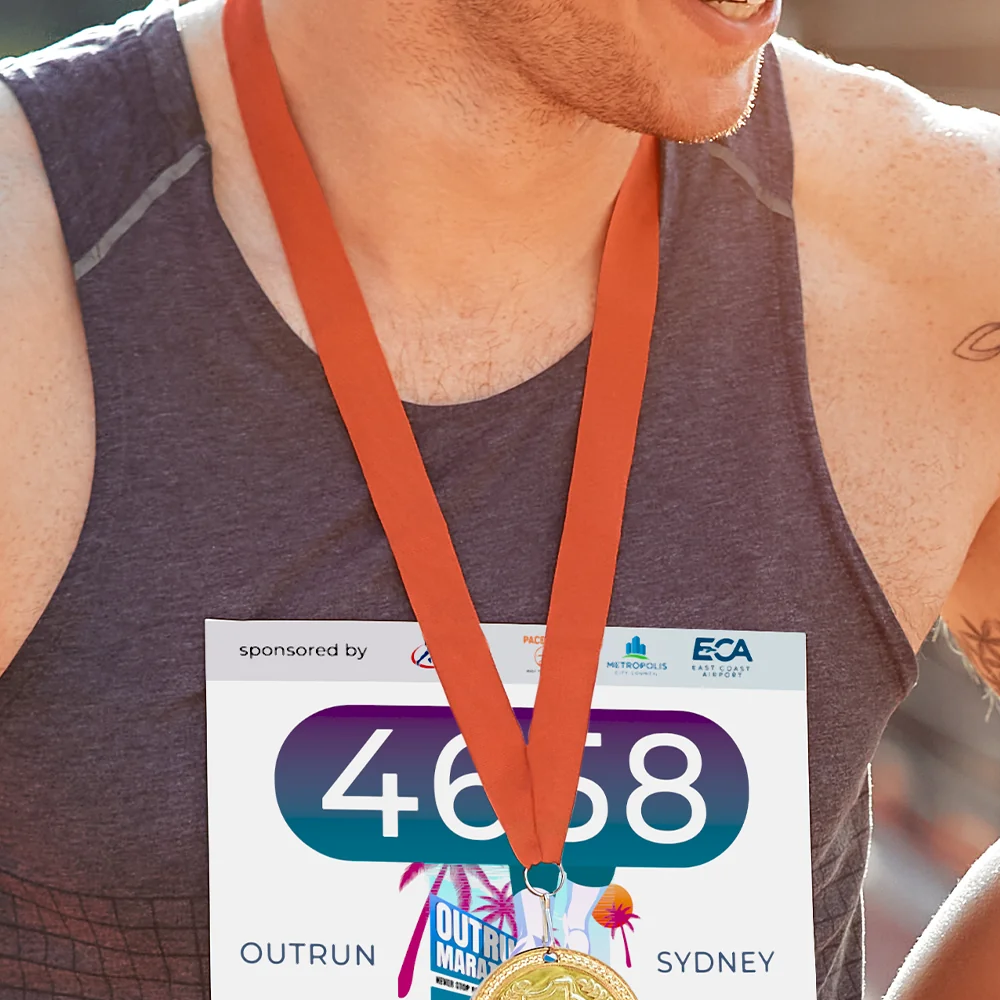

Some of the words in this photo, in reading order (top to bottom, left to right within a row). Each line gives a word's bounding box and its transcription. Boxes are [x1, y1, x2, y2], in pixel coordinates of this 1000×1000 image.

[239, 643, 338, 661] sponsored
[345, 643, 367, 660] by
[692, 637, 753, 662] ECA
[606, 661, 668, 670] METROPOLIS
[240, 942, 375, 966] OUTRUN
[657, 951, 775, 973] SYDNEY
